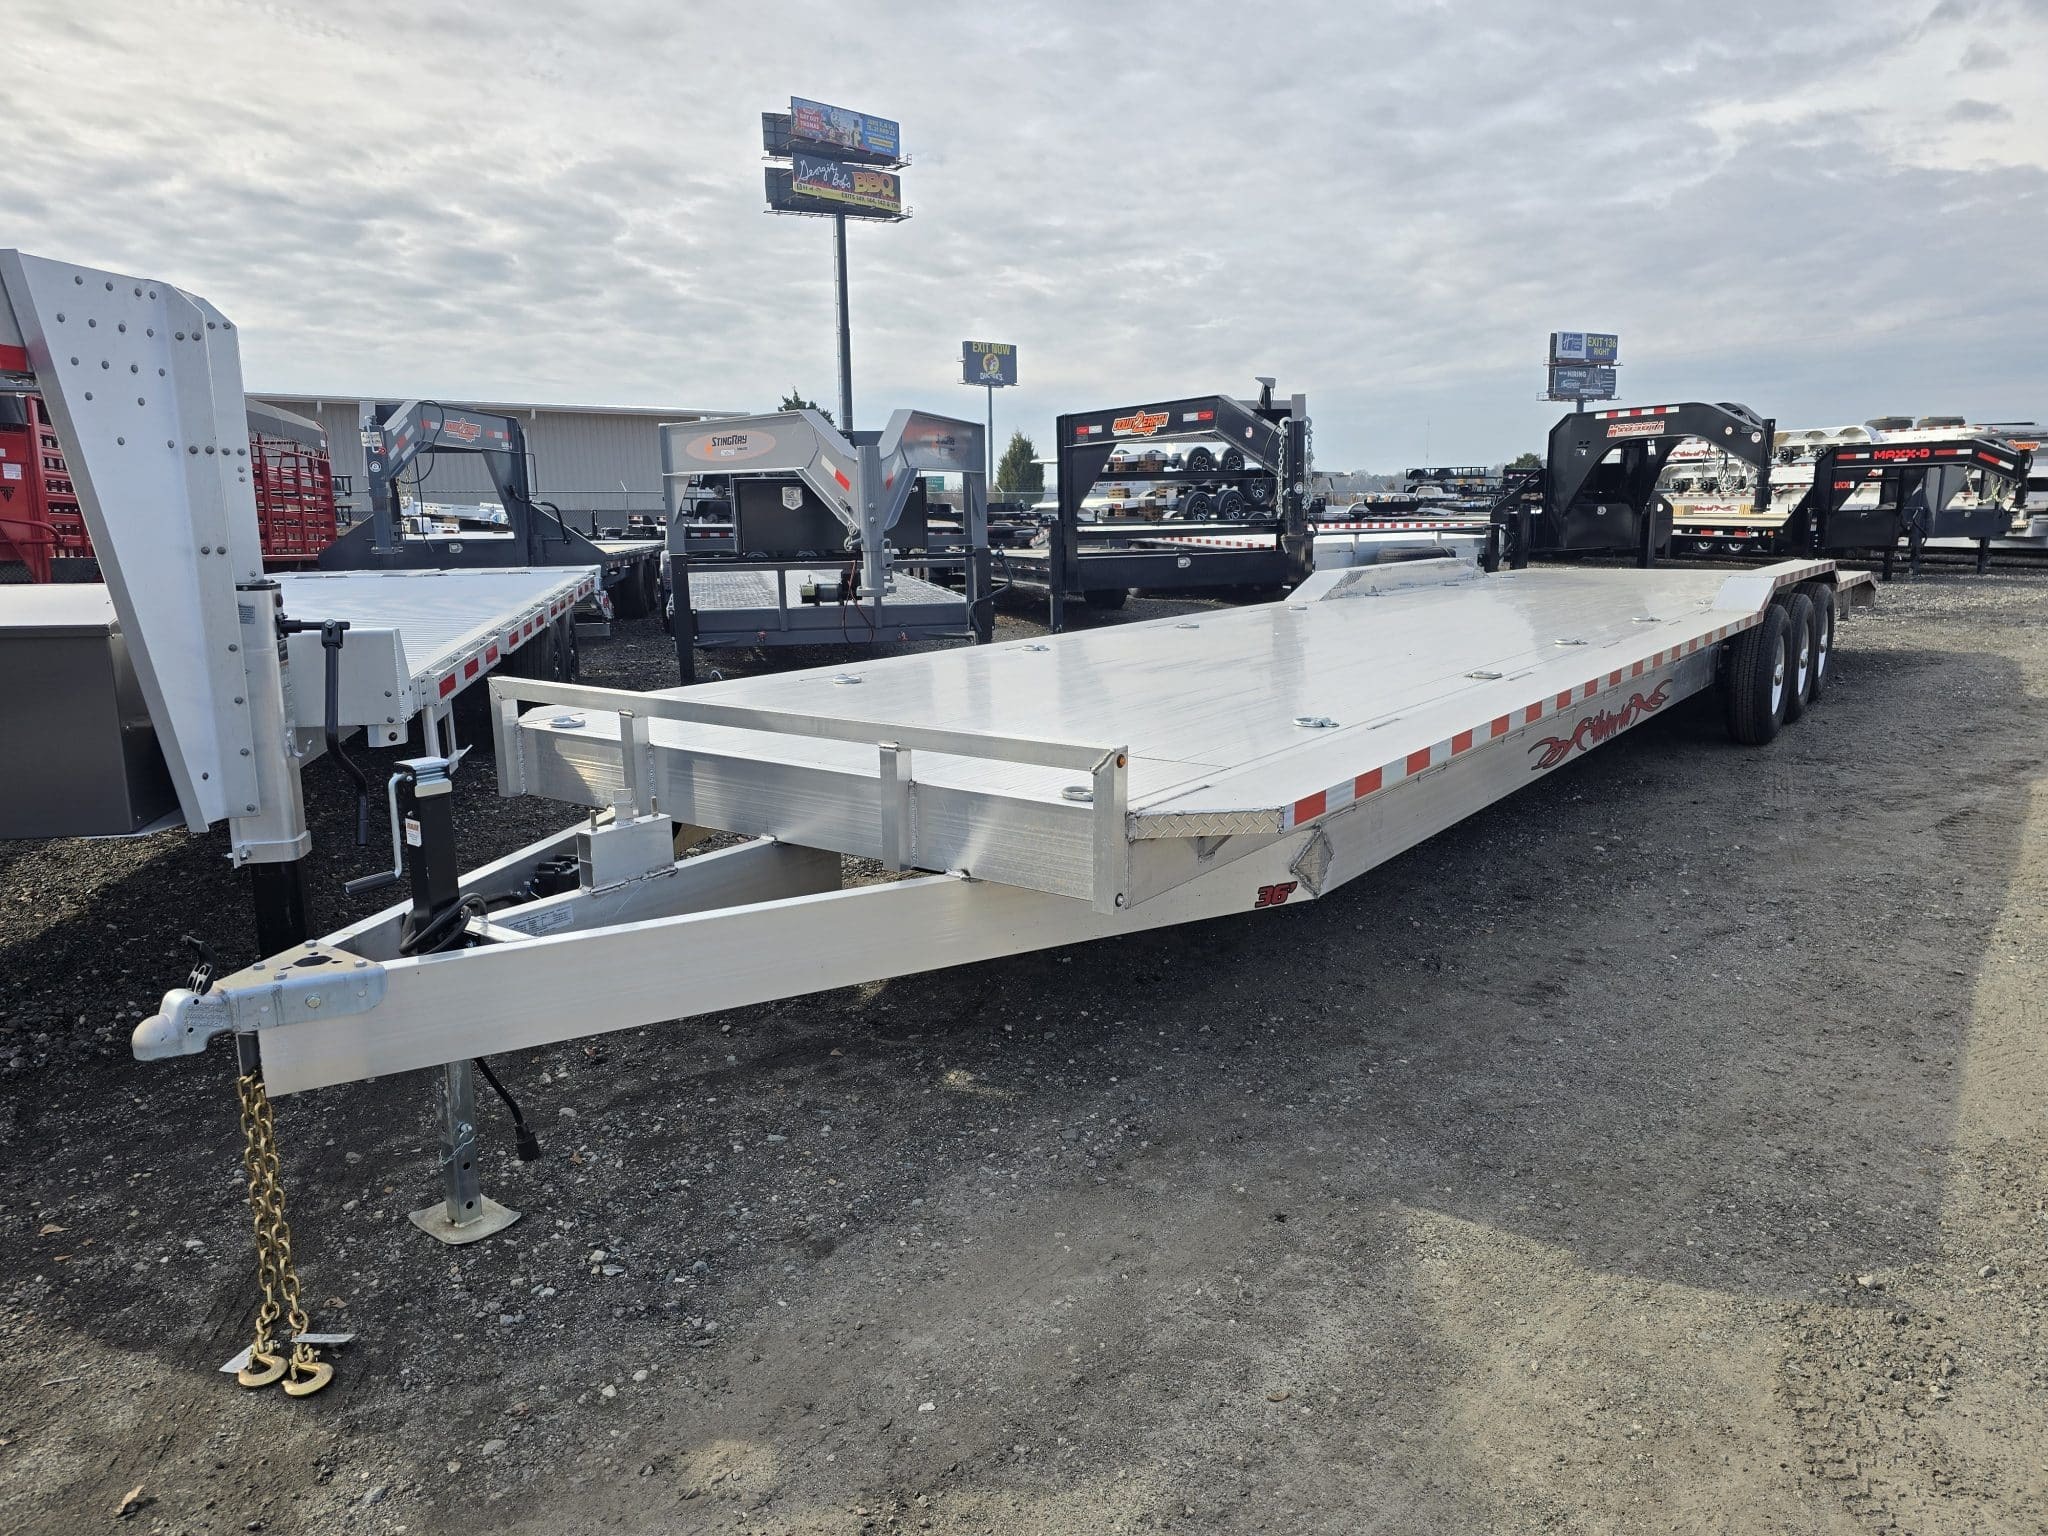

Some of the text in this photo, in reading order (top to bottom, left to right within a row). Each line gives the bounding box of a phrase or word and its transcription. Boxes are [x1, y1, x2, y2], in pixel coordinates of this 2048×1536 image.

[852, 171, 895, 197] BBQ
[1587, 336, 1603, 347] EXIT
[1604, 338, 1617, 348] 136
[972, 342, 1011, 355] EXIT NOW
[1593, 347, 1610, 356] RIGHT
[1567, 370, 1587, 378] HIRING
[1873, 448, 1930, 460] MAXX-D
